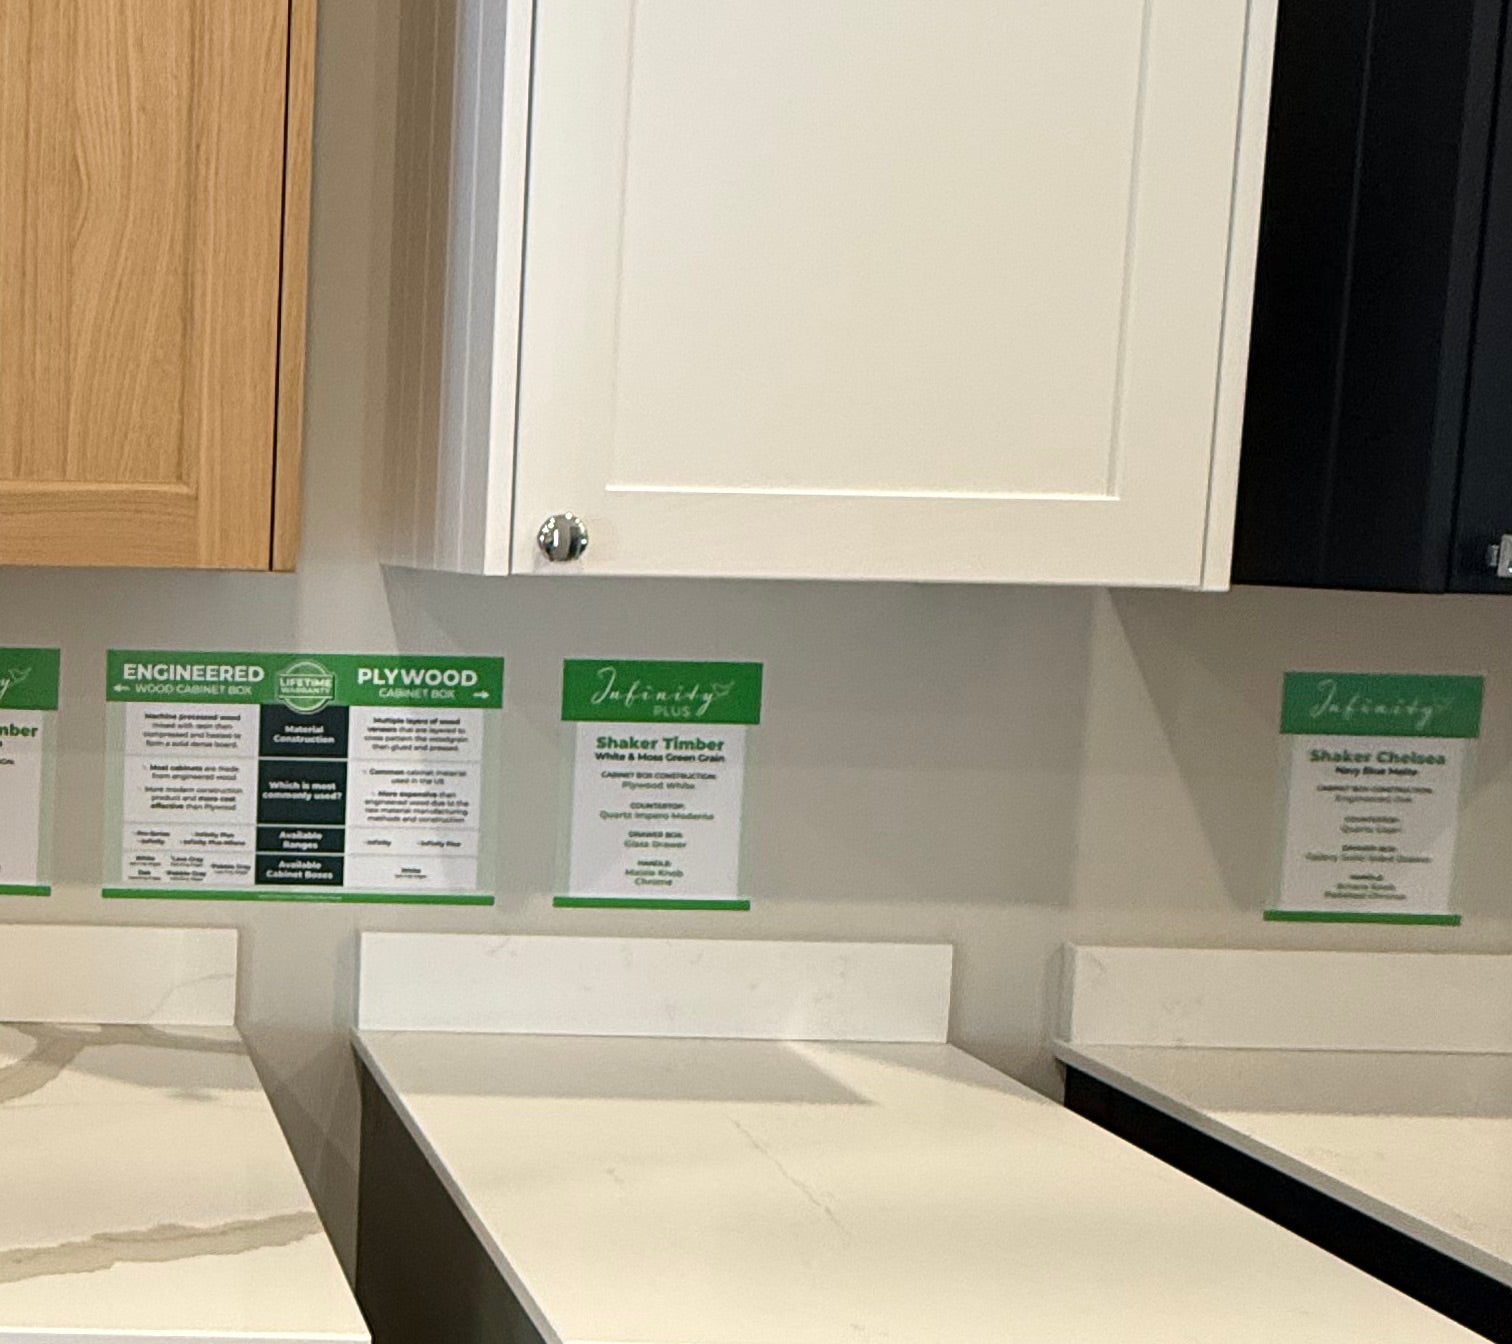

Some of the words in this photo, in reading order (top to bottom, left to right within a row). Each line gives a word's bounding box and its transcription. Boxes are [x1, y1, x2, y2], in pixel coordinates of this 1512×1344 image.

[123, 664, 265, 682] ENGINEERED
[357, 668, 478, 686] PLYWOOD
[280, 678, 333, 686] LIFETIME
[136, 684, 174, 694] WOOD
[176, 684, 226, 694] CABINET
[228, 686, 252, 695] BOX
[379, 688, 428, 698] CABINET
[431, 689, 456, 699] BOX
[591, 666, 714, 718] Infinity
[653, 706, 692, 717] PLUS
[284, 725, 324, 733] Material
[273, 734, 335, 743] Construction
[596, 736, 658, 750] Shaker
[662, 736, 724, 751] Timber
[595, 752, 625, 761] White
[628, 753, 635, 761] &
[638, 753, 663, 761] Moss
[665, 754, 695, 762] Green
[698, 754, 725, 763] Grain
[1310, 749, 1371, 762] Shaker
[1376, 751, 1446, 765] Chelsea
[269, 781, 300, 790] Which
[262, 792, 311, 801] commonly
[313, 792, 342, 800] used?
[279, 831, 323, 839] Available
[283, 840, 319, 850] Ranges
[278, 860, 322, 869] Available
[266, 870, 302, 878] Cabinet
